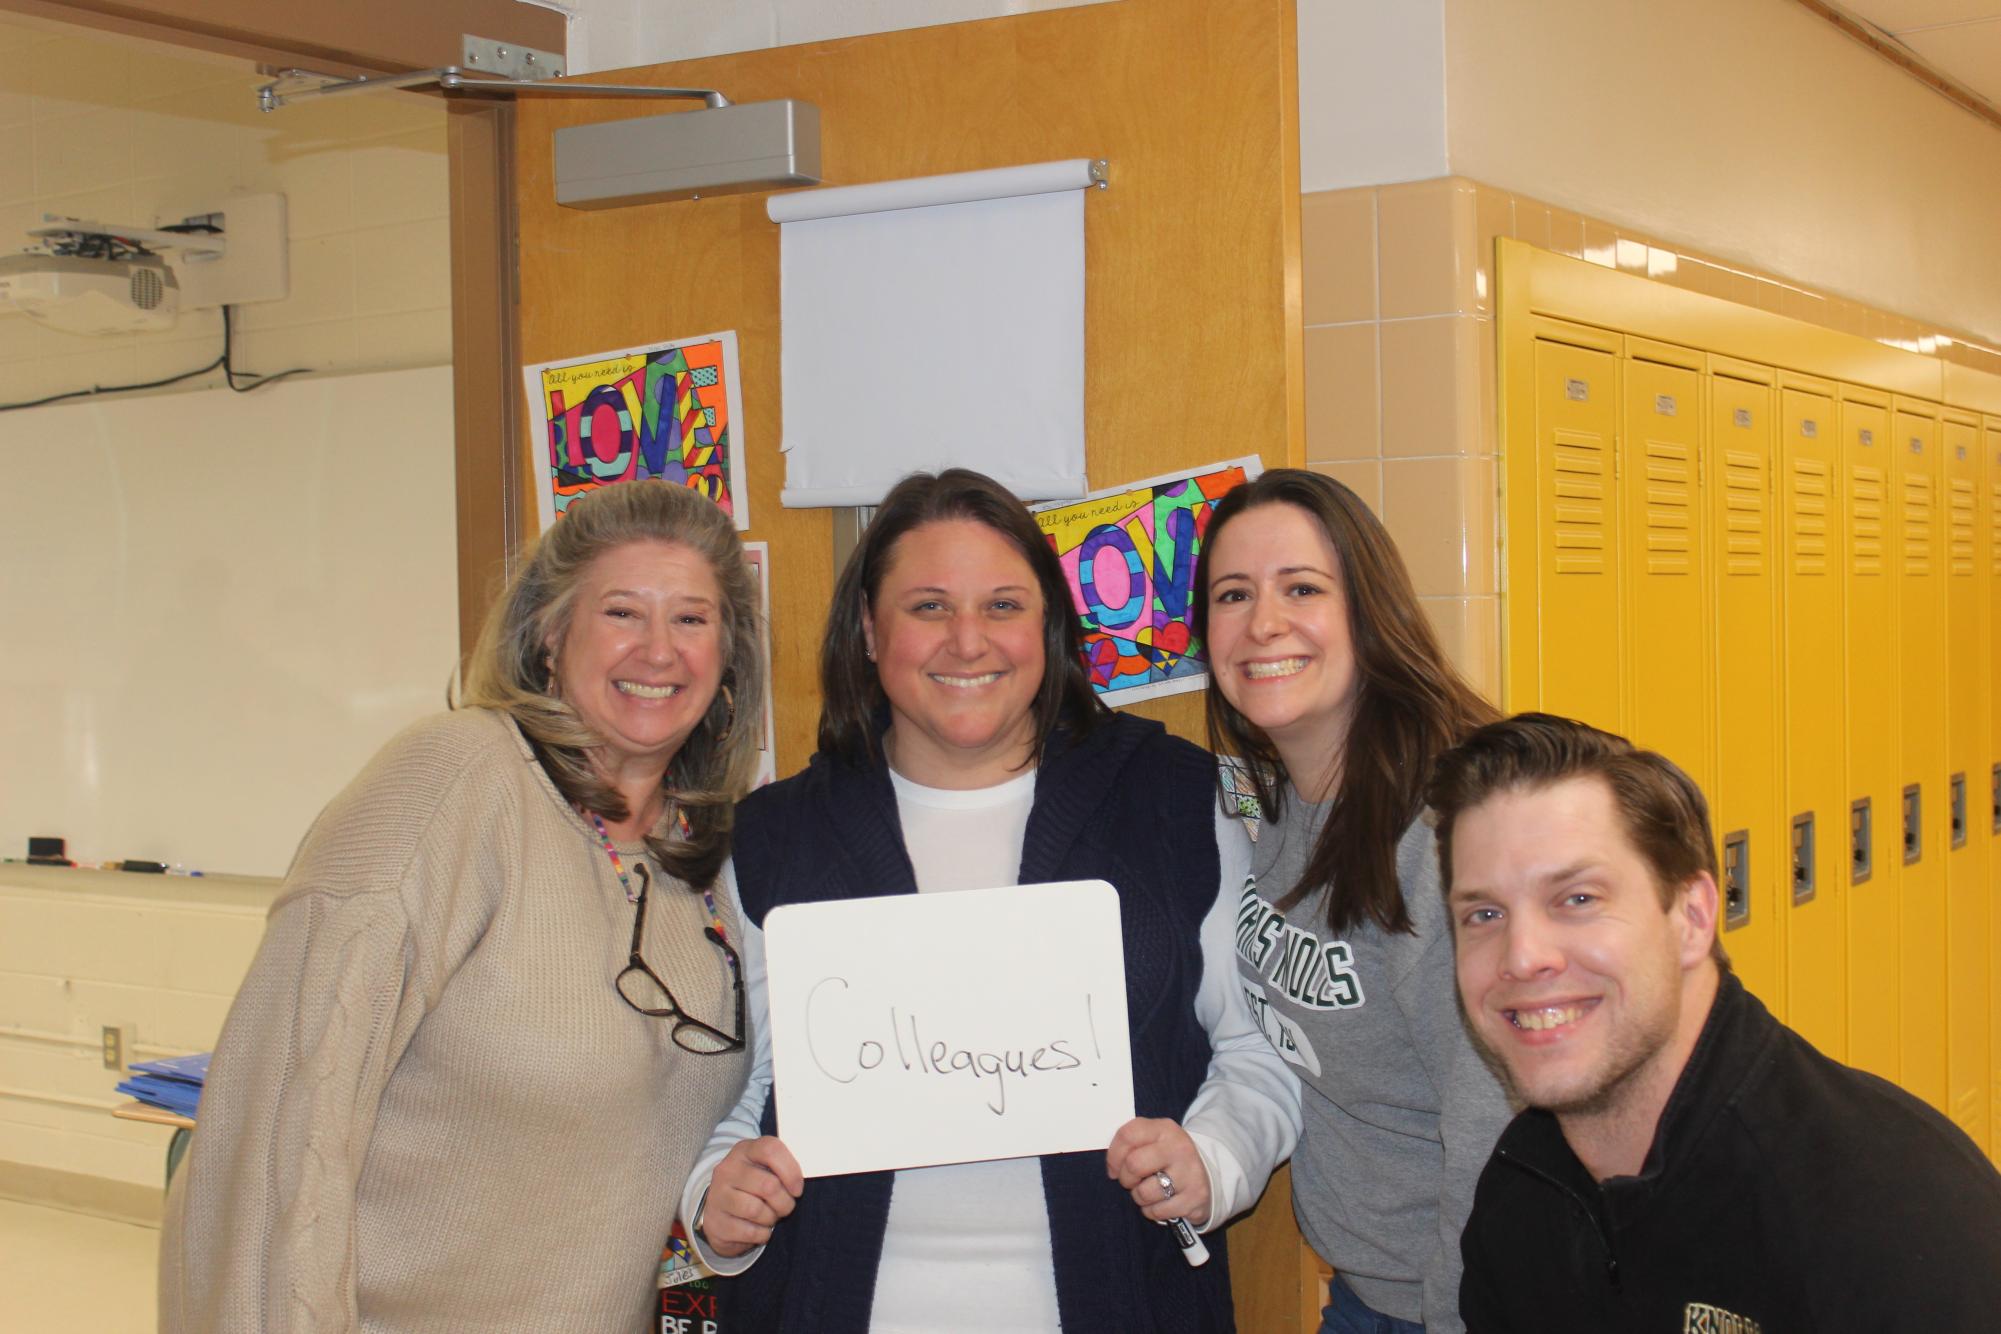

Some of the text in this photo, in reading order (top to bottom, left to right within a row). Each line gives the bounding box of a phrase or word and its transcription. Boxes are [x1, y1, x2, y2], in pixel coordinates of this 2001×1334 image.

[571, 372, 592, 384] you
[594, 365, 619, 378] need
[550, 365, 724, 480] LOVE
[1063, 510, 1088, 527] you
[1091, 500, 1121, 518] need
[806, 976, 1101, 1116] Colleagues!
